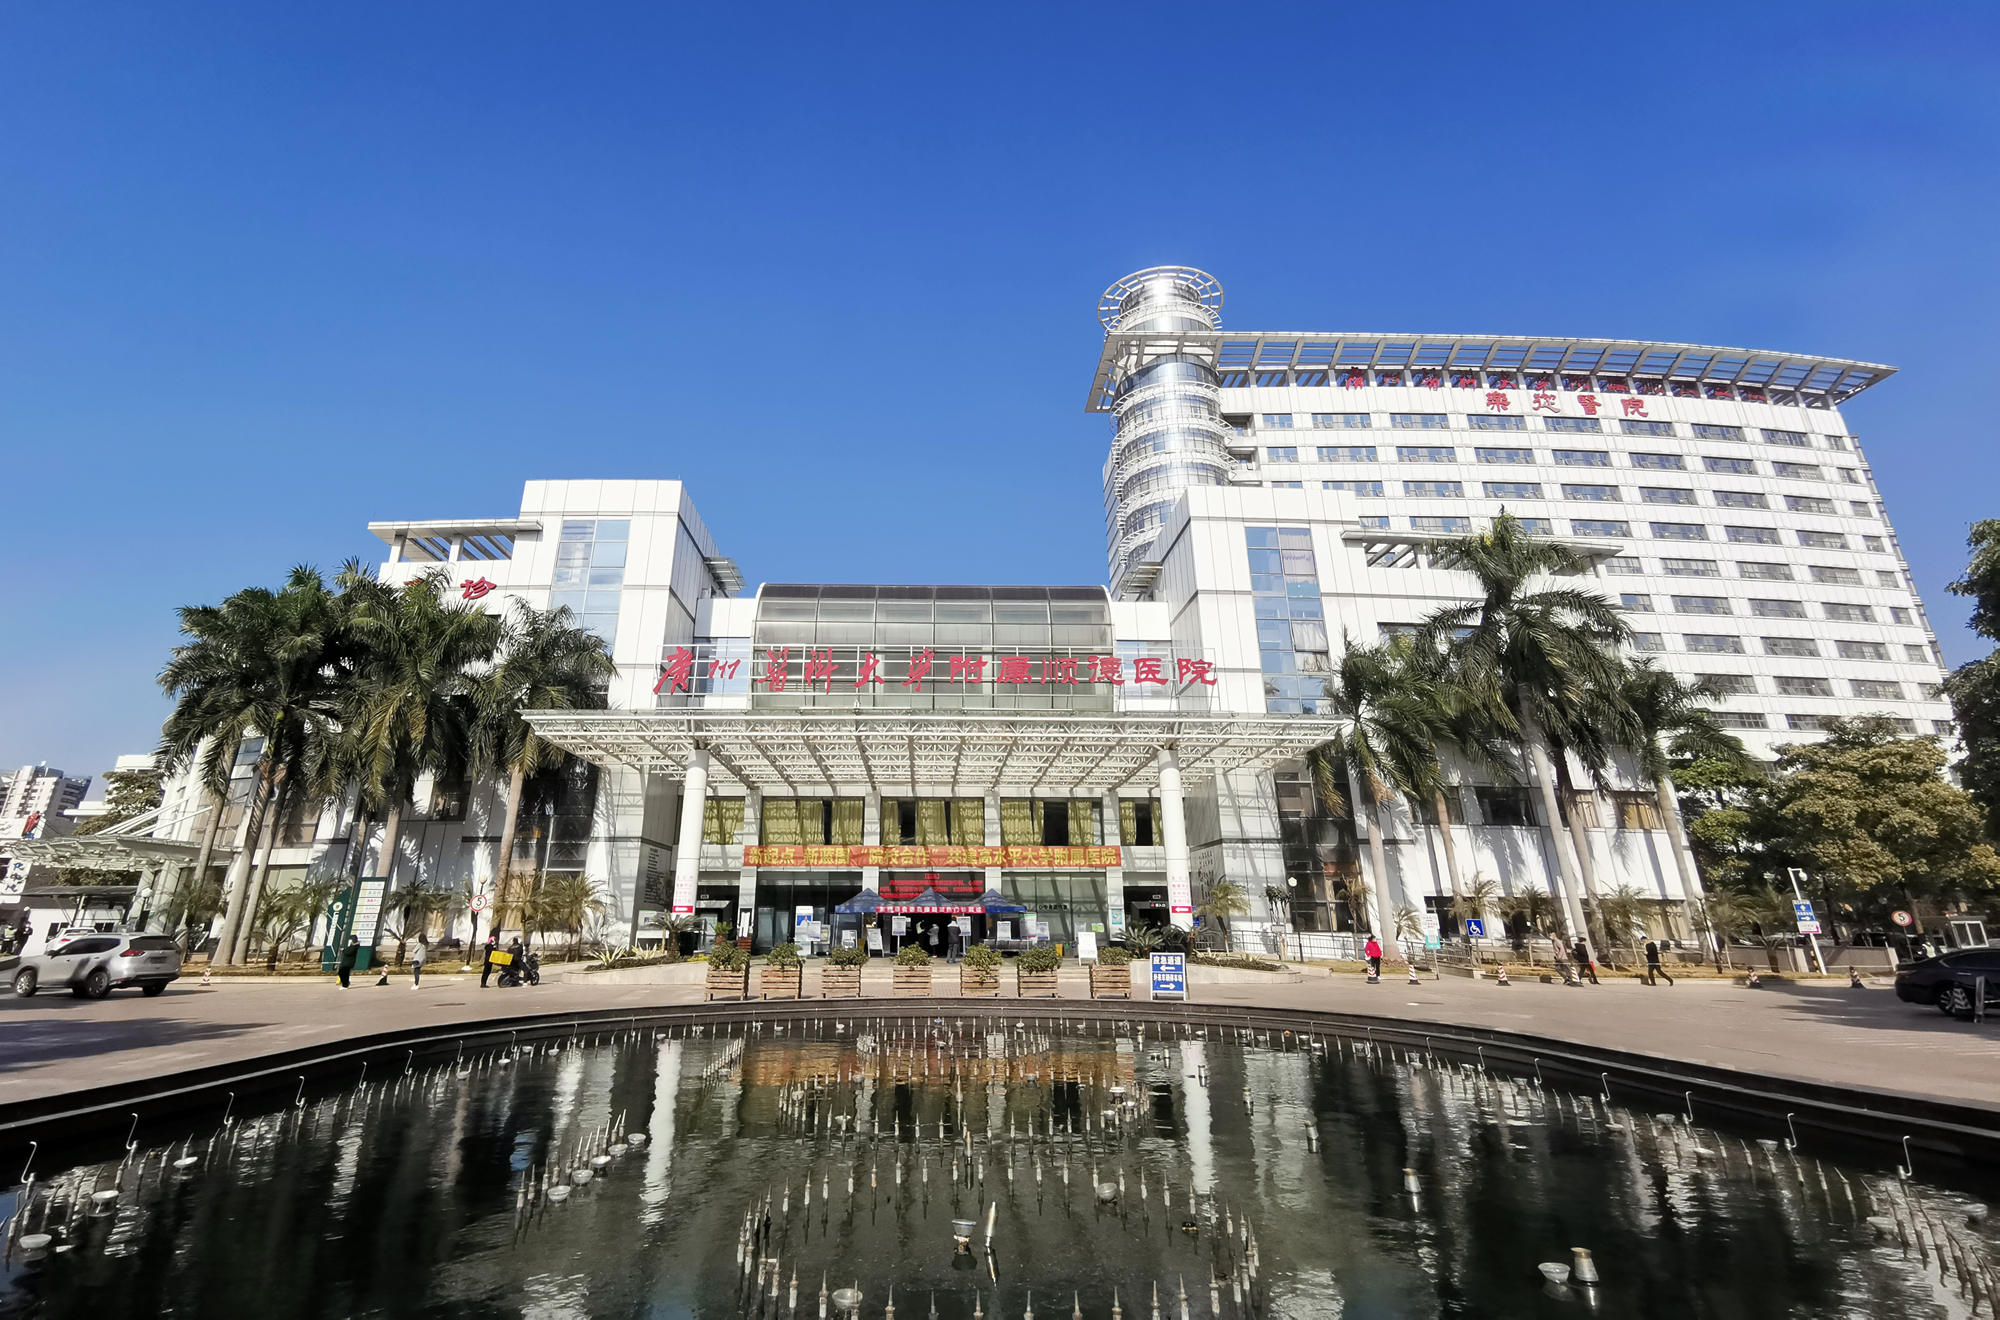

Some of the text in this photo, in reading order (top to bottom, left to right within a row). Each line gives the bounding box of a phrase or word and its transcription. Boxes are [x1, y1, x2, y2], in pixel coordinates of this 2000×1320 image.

[749, 847, 795, 865] 新起点
[804, 848, 850, 865] 新蓝图
[947, 848, 1117, 865] 共建高水平大学附属医院
